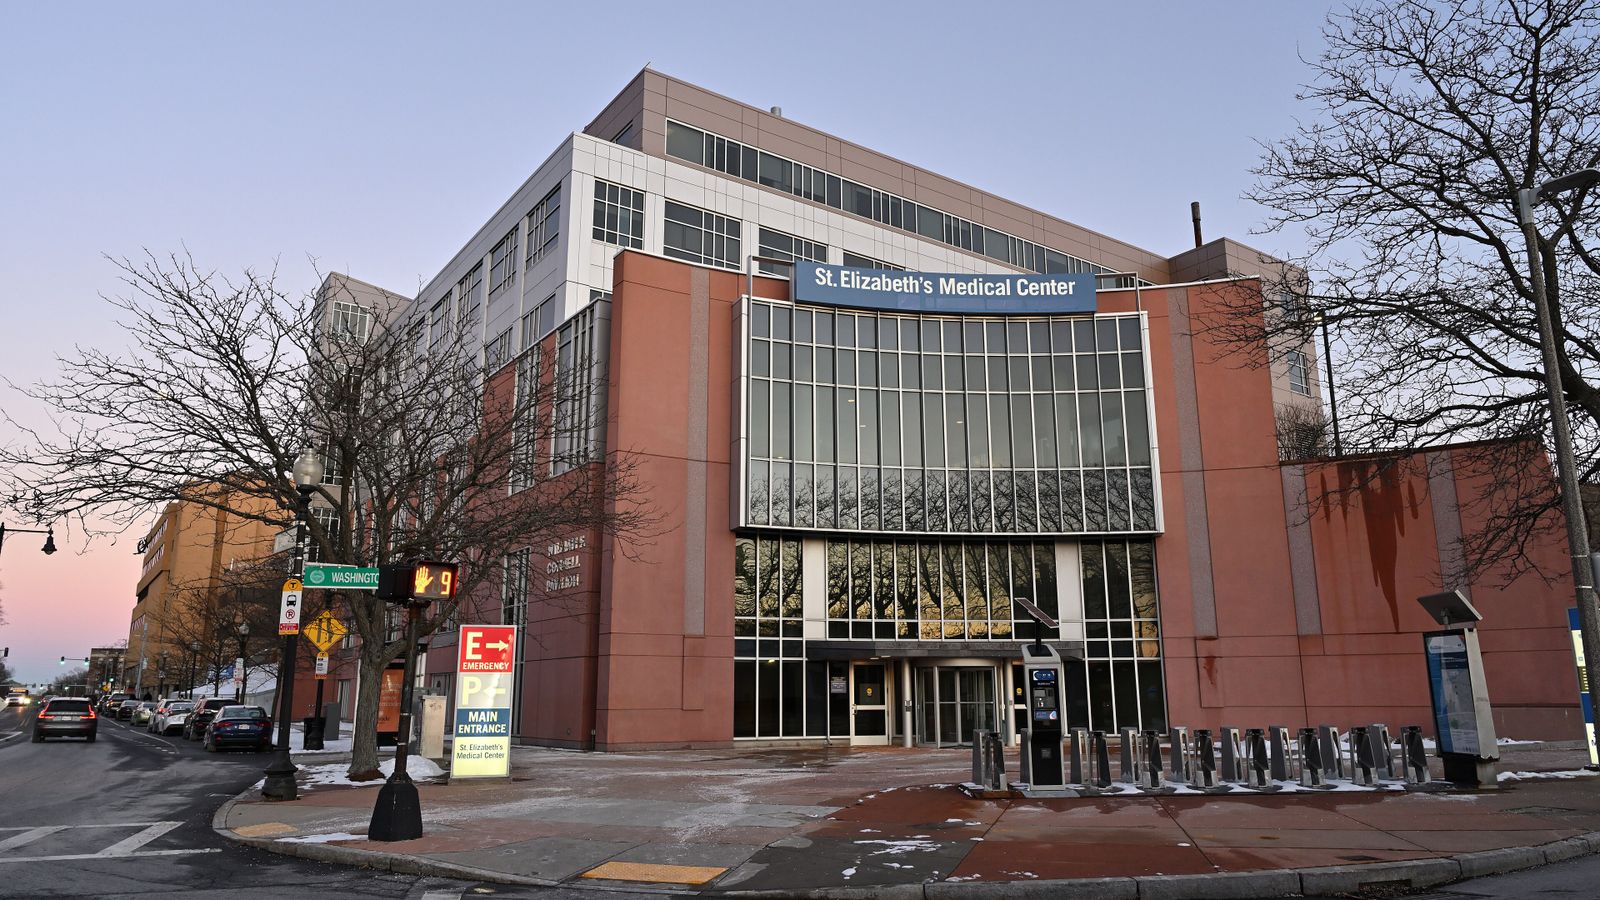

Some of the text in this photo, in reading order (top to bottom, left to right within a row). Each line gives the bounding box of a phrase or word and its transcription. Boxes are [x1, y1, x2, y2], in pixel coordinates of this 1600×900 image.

[815, 268, 1075, 296] St. Elizabeth’s Medical Center
[441, 571, 452, 595] 9
[465, 631, 483, 660] E
[462, 662, 510, 670] EMERGENCY
[462, 676, 482, 706] P
[468, 711, 498, 723] MAIN
[458, 723, 507, 734] ENTRANCE
[469, 743, 504, 751] Elizabeth's
[456, 751, 505, 760] Medical Center
